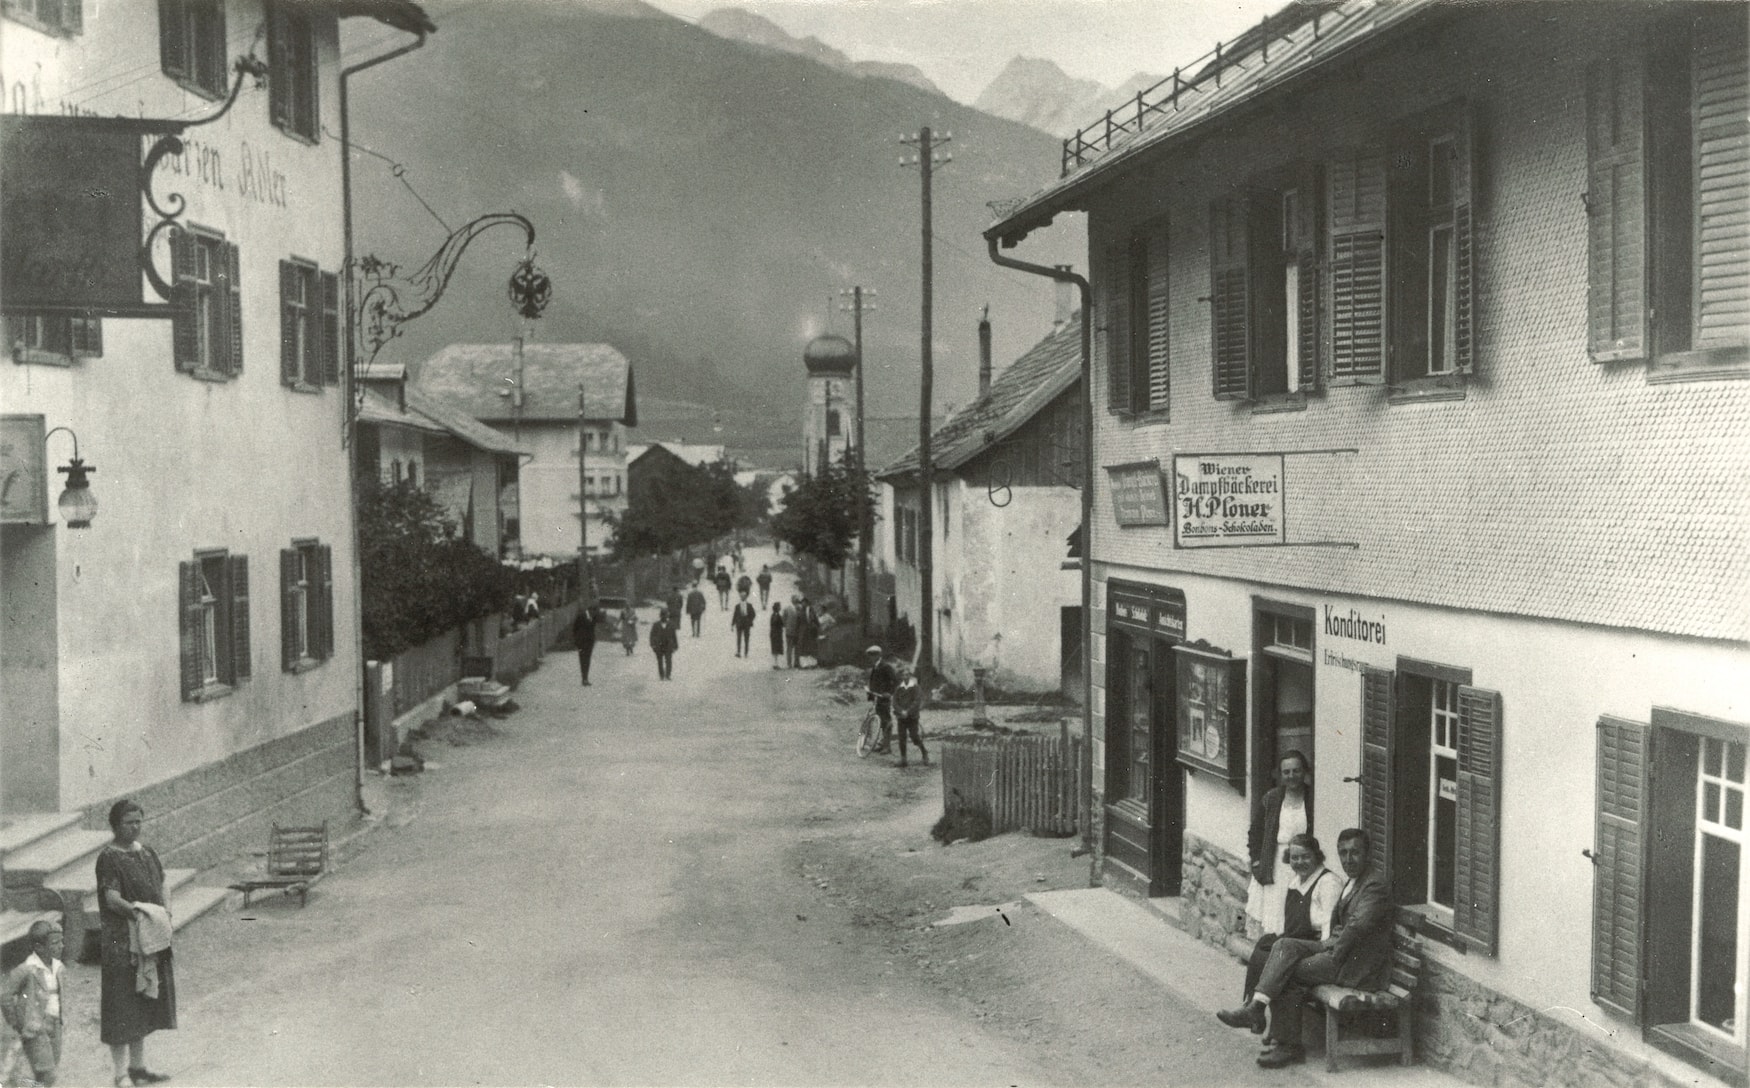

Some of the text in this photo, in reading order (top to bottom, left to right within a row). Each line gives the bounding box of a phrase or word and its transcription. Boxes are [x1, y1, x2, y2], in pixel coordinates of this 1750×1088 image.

[1200, 462, 1252, 475] Wiener
[1177, 472, 1278, 501] Dampfbäckerei
[1324, 604, 1386, 645] Konditorei
